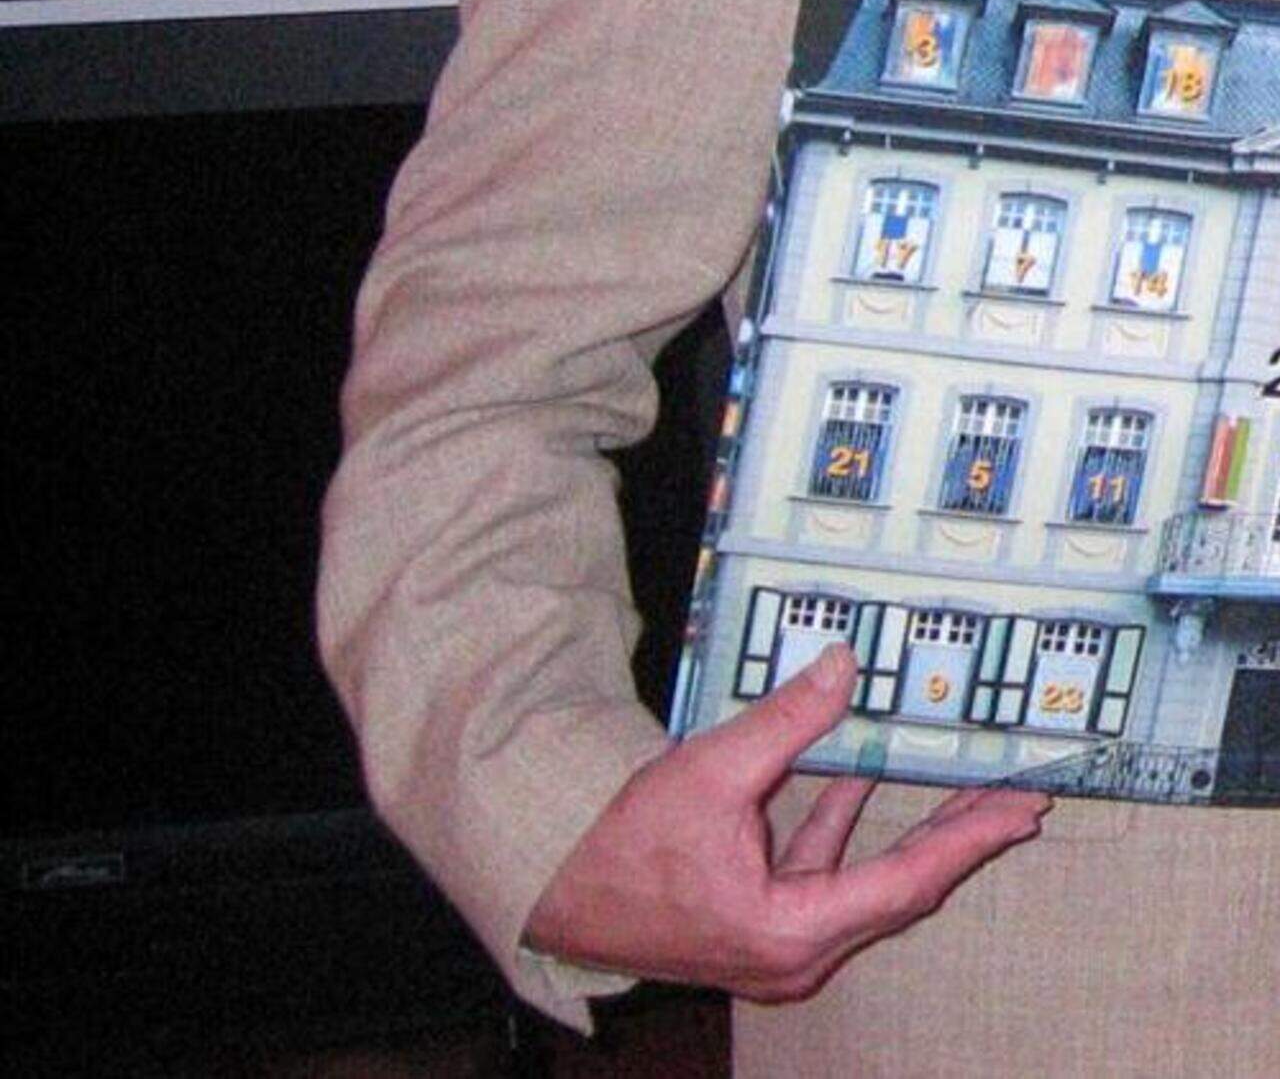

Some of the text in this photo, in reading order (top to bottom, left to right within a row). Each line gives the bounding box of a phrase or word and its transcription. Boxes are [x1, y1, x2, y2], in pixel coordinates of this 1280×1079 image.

[828, 446, 869, 478] 21
[968, 461, 992, 491] 5
[1088, 472, 1128, 502] 11
[928, 676, 949, 702] 9
[1040, 684, 1084, 713] 23
